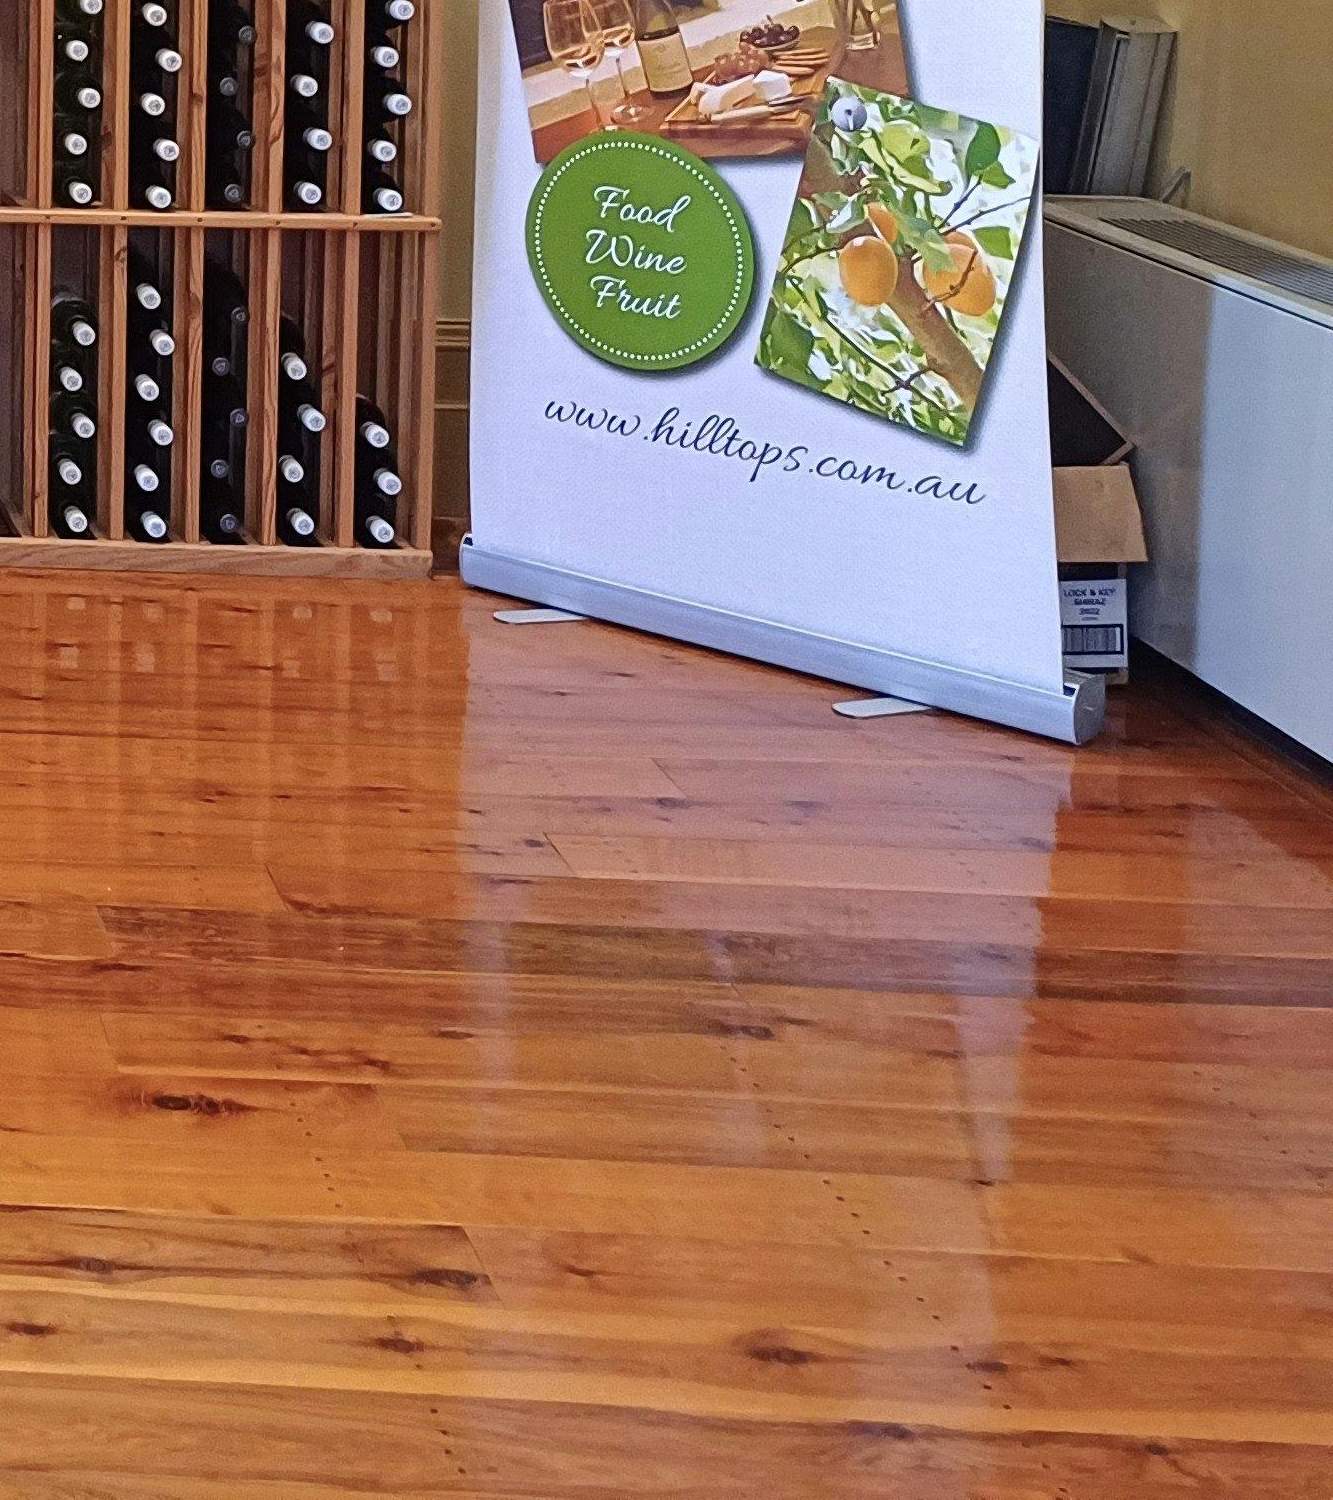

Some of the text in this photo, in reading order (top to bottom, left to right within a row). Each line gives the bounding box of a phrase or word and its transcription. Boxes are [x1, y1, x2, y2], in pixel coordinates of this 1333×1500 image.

[593, 185, 691, 233] Food
[585, 229, 687, 275] Wine
[590, 275, 682, 319] Fruit
[544, 400, 988, 505] www.hilltops.com.au
